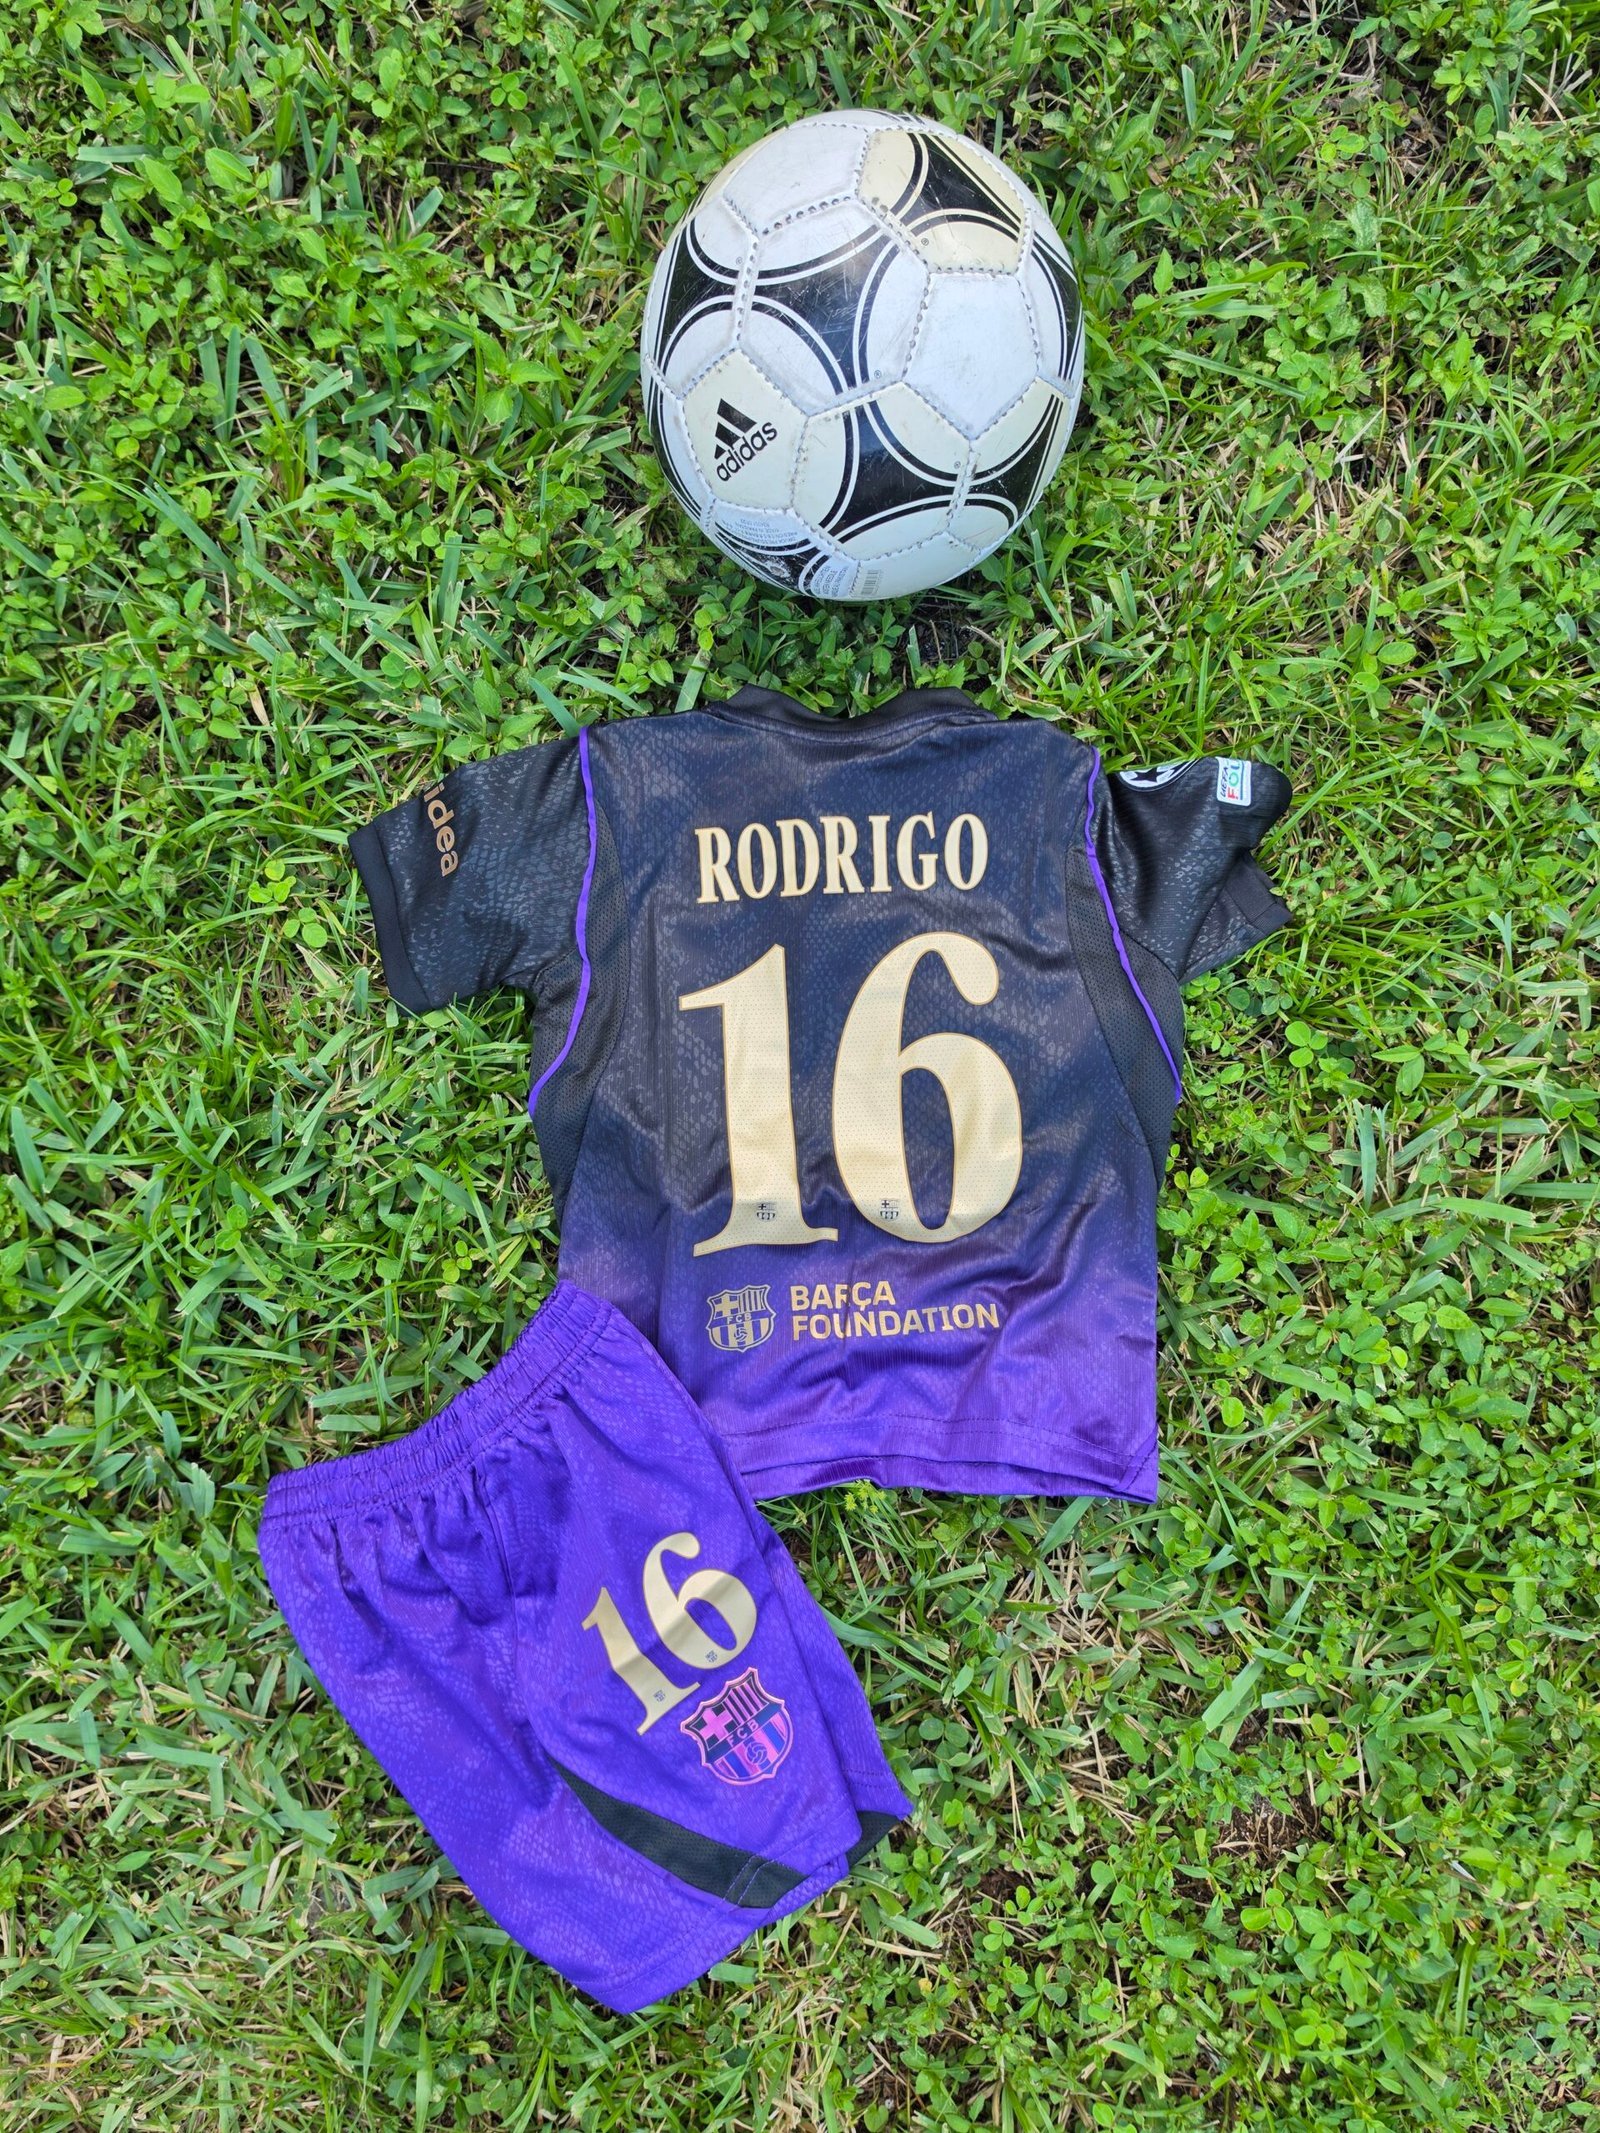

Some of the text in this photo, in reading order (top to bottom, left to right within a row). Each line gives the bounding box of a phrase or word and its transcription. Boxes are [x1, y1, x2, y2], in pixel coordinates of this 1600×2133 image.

[716, 421, 778, 482] adidas
[694, 811, 989, 905] RODRIGO
[678, 931, 1024, 1258] 16
[726, 1312, 752, 1325] FCB
[790, 1280, 896, 1312] BARÇA
[792, 1303, 1000, 1341] FOUNDATION
[581, 1531, 758, 1736] 16
[726, 1719, 759, 1748] FCB
